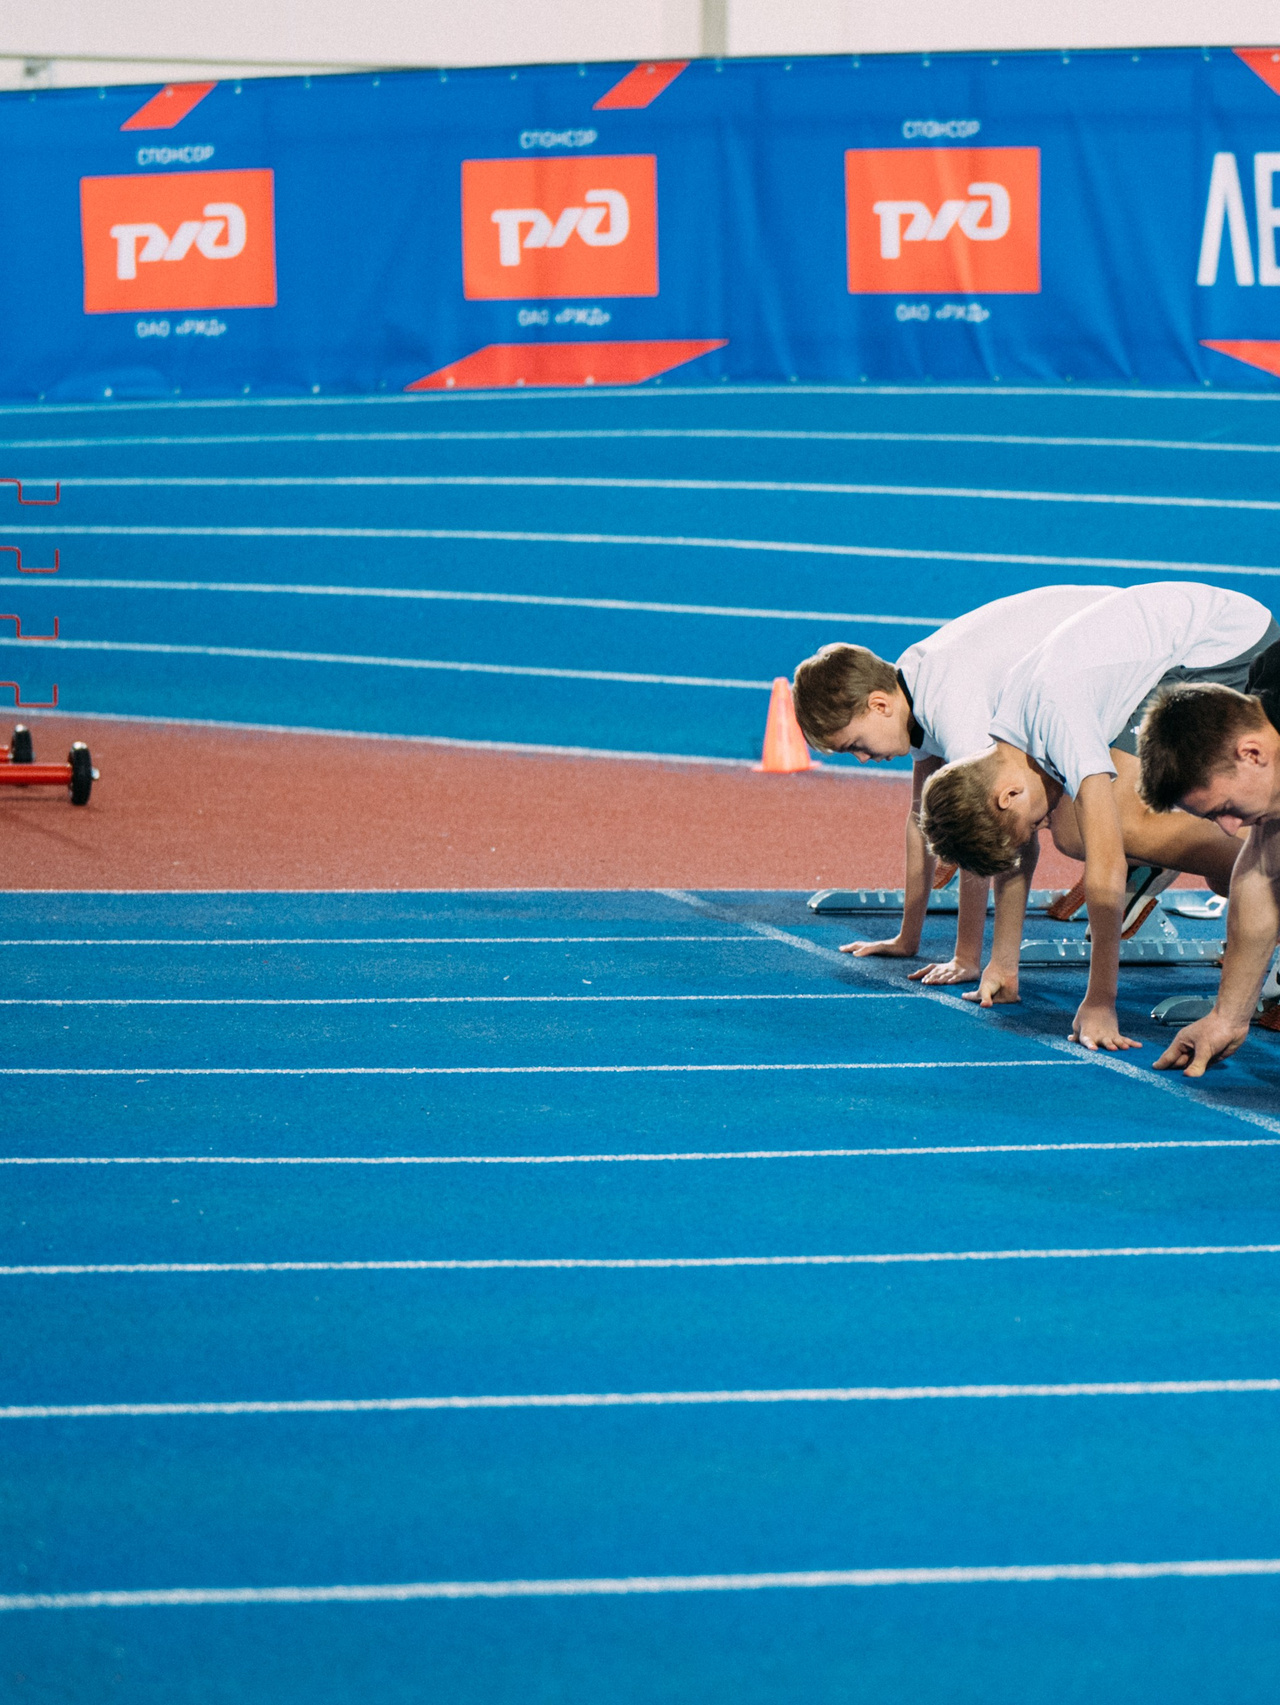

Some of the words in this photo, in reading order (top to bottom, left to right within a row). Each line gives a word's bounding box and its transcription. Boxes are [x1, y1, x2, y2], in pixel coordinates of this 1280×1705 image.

[903, 121, 980, 138] СПОНСОР
[520, 130, 597, 149] СПОНСОР
[138, 146, 215, 165] СПОНСОР
[518, 309, 549, 326] ОАО
[896, 304, 930, 321] ОАО
[137, 321, 170, 337] ОАО
